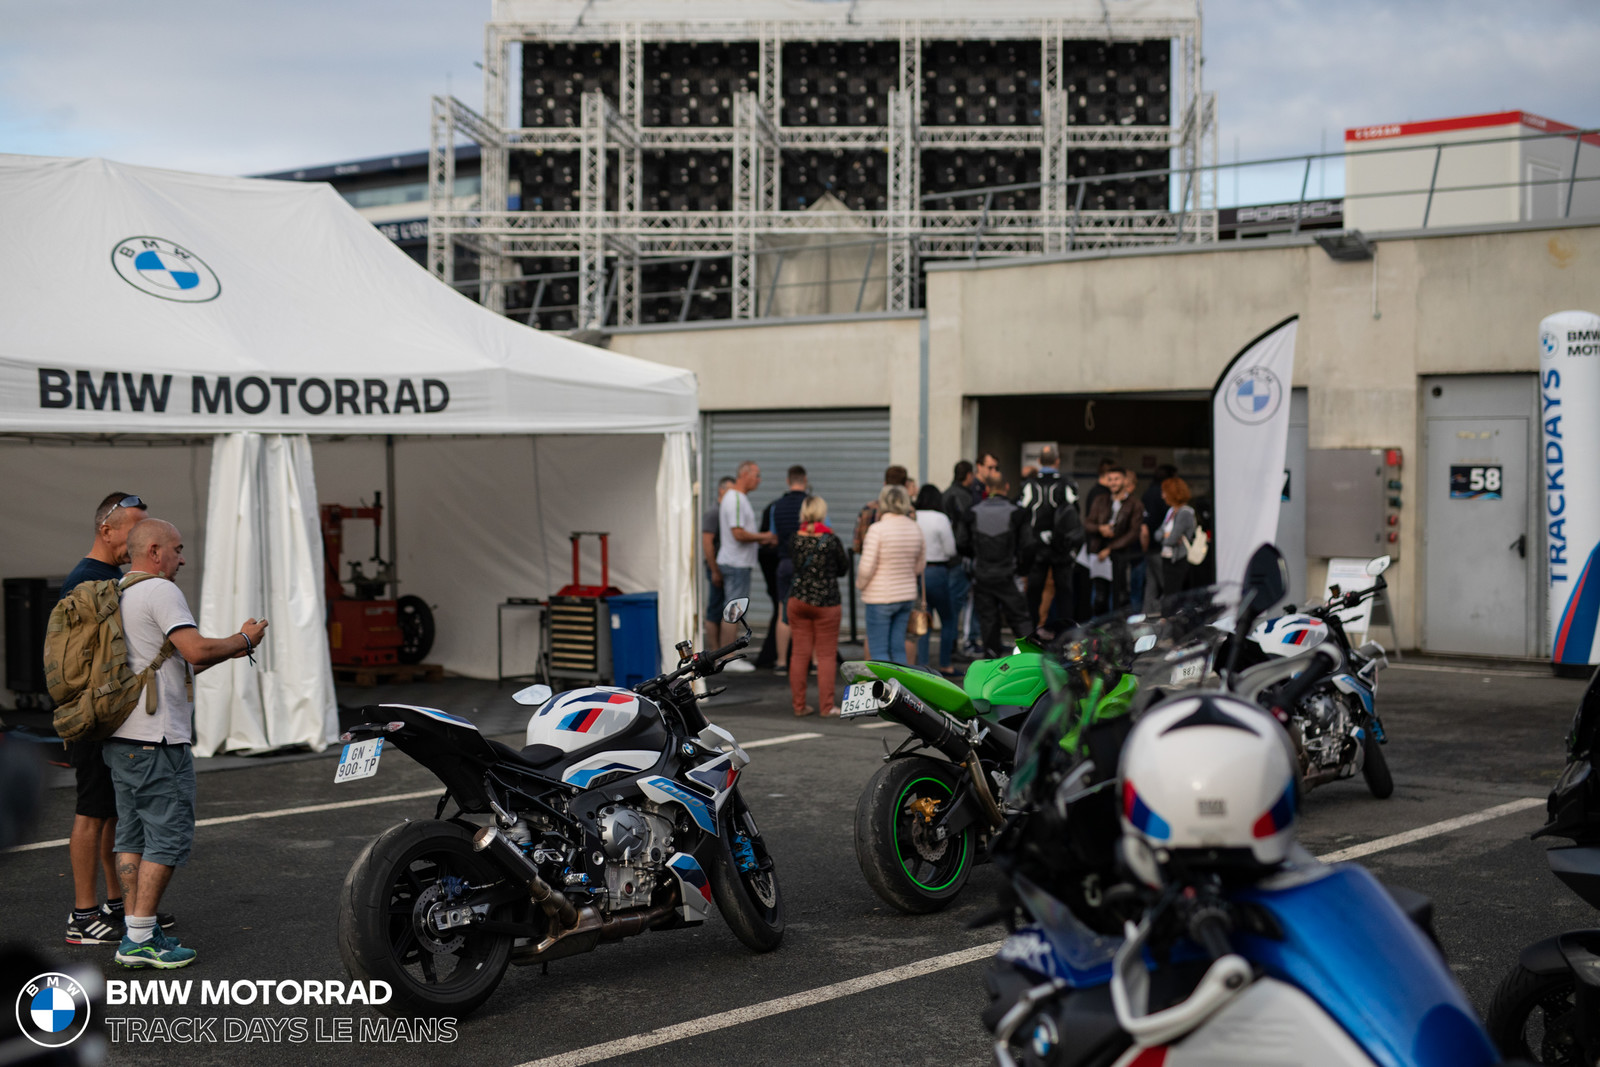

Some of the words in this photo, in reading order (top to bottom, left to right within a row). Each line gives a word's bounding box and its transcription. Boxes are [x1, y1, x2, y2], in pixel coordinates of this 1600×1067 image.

[119, 240, 191, 259] BMW
[37, 367, 174, 413] BMW
[191, 375, 450, 415] MOTORRAD
[1469, 467, 1501, 491] 58
[1542, 368, 1569, 587] TRACKDAYS
[654, 782, 704, 807] 1000
